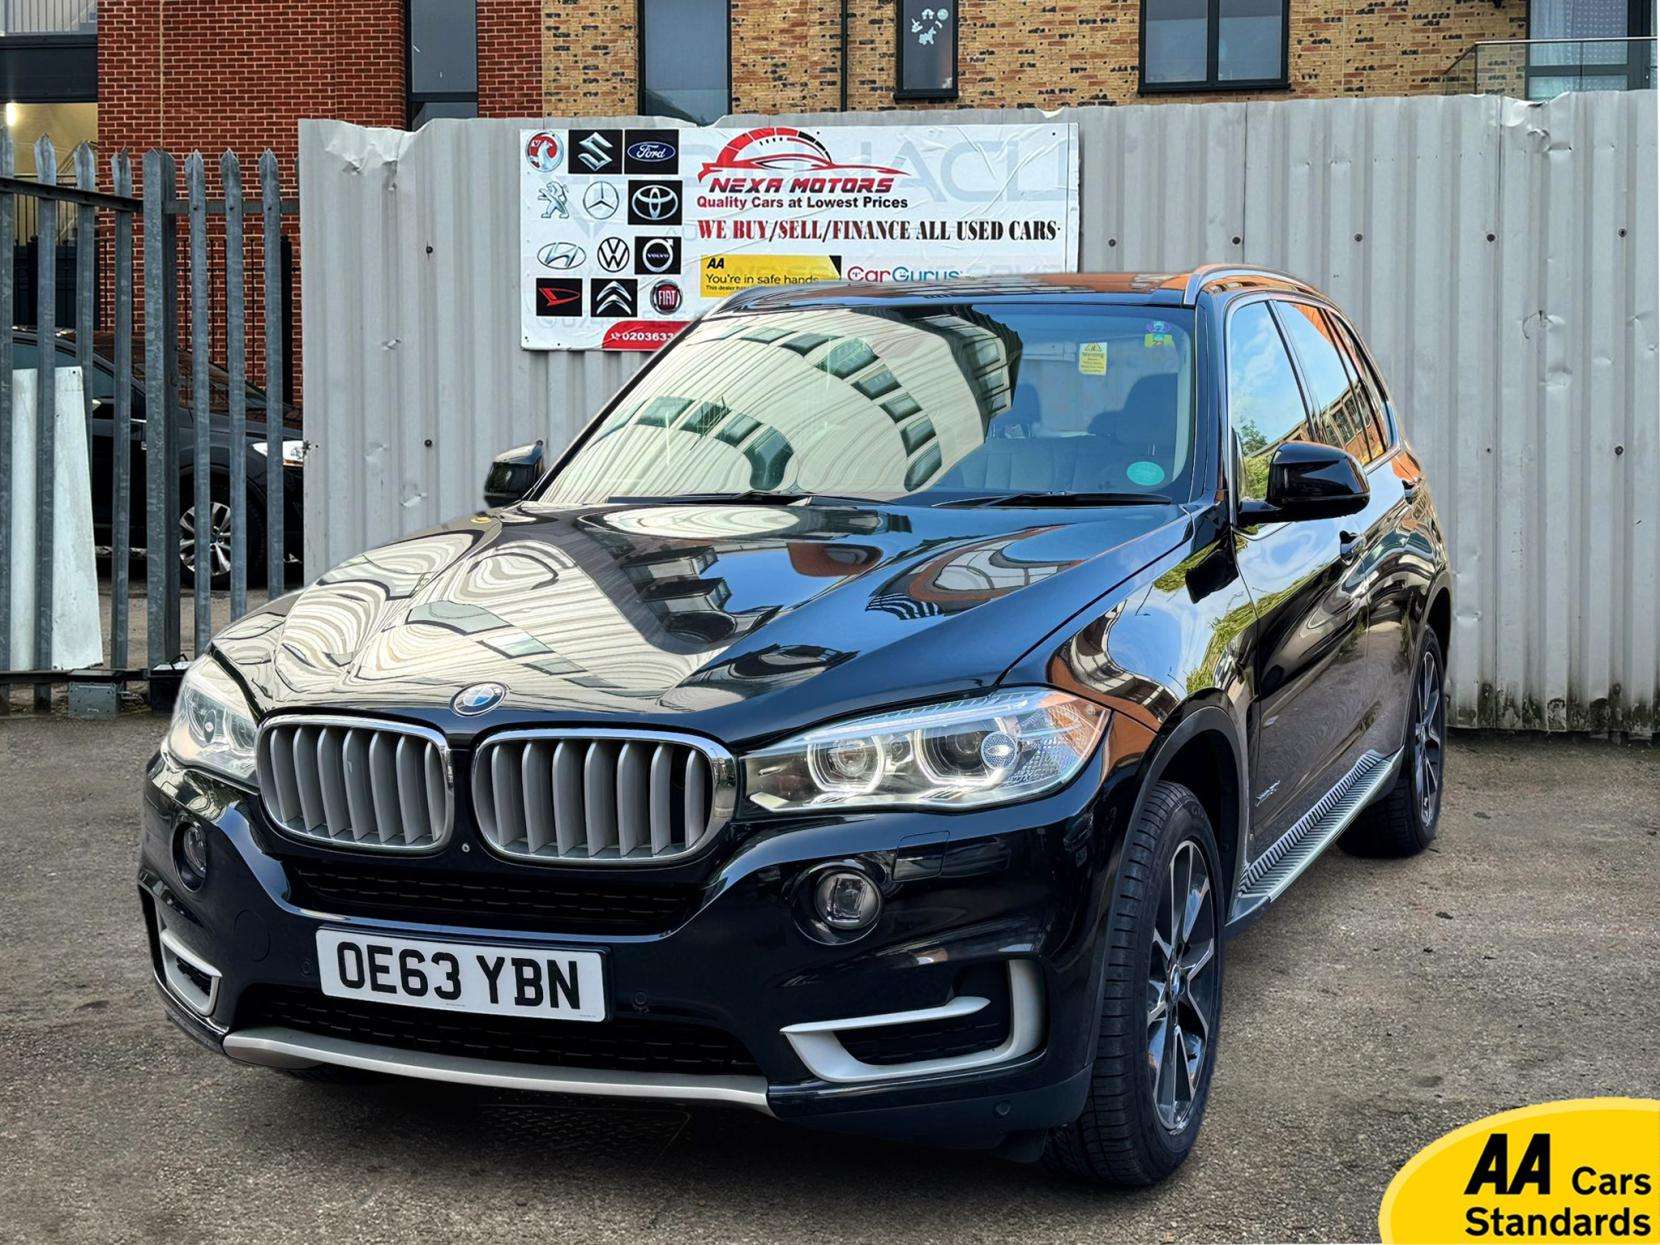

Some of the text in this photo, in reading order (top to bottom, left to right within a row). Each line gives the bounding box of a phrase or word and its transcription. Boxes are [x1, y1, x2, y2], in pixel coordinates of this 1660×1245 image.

[636, 144, 666, 158] Ford
[709, 178, 894, 193] NEXA MOTORS
[697, 196, 908, 210] Quality Cars at Lowest Prices
[697, 220, 727, 240] WE
[916, 220, 950, 240] ALL
[957, 220, 1003, 240] USED
[1009, 220, 1057, 240] CARS
[707, 257, 725, 269] AA
[705, 274, 741, 284] You're
[744, 274, 754, 284] in
[757, 274, 781, 284] safe
[847, 266, 960, 283] CarGurus
[658, 290, 677, 306] FIAT
[336, 941, 581, 1010] OE63 YBN
